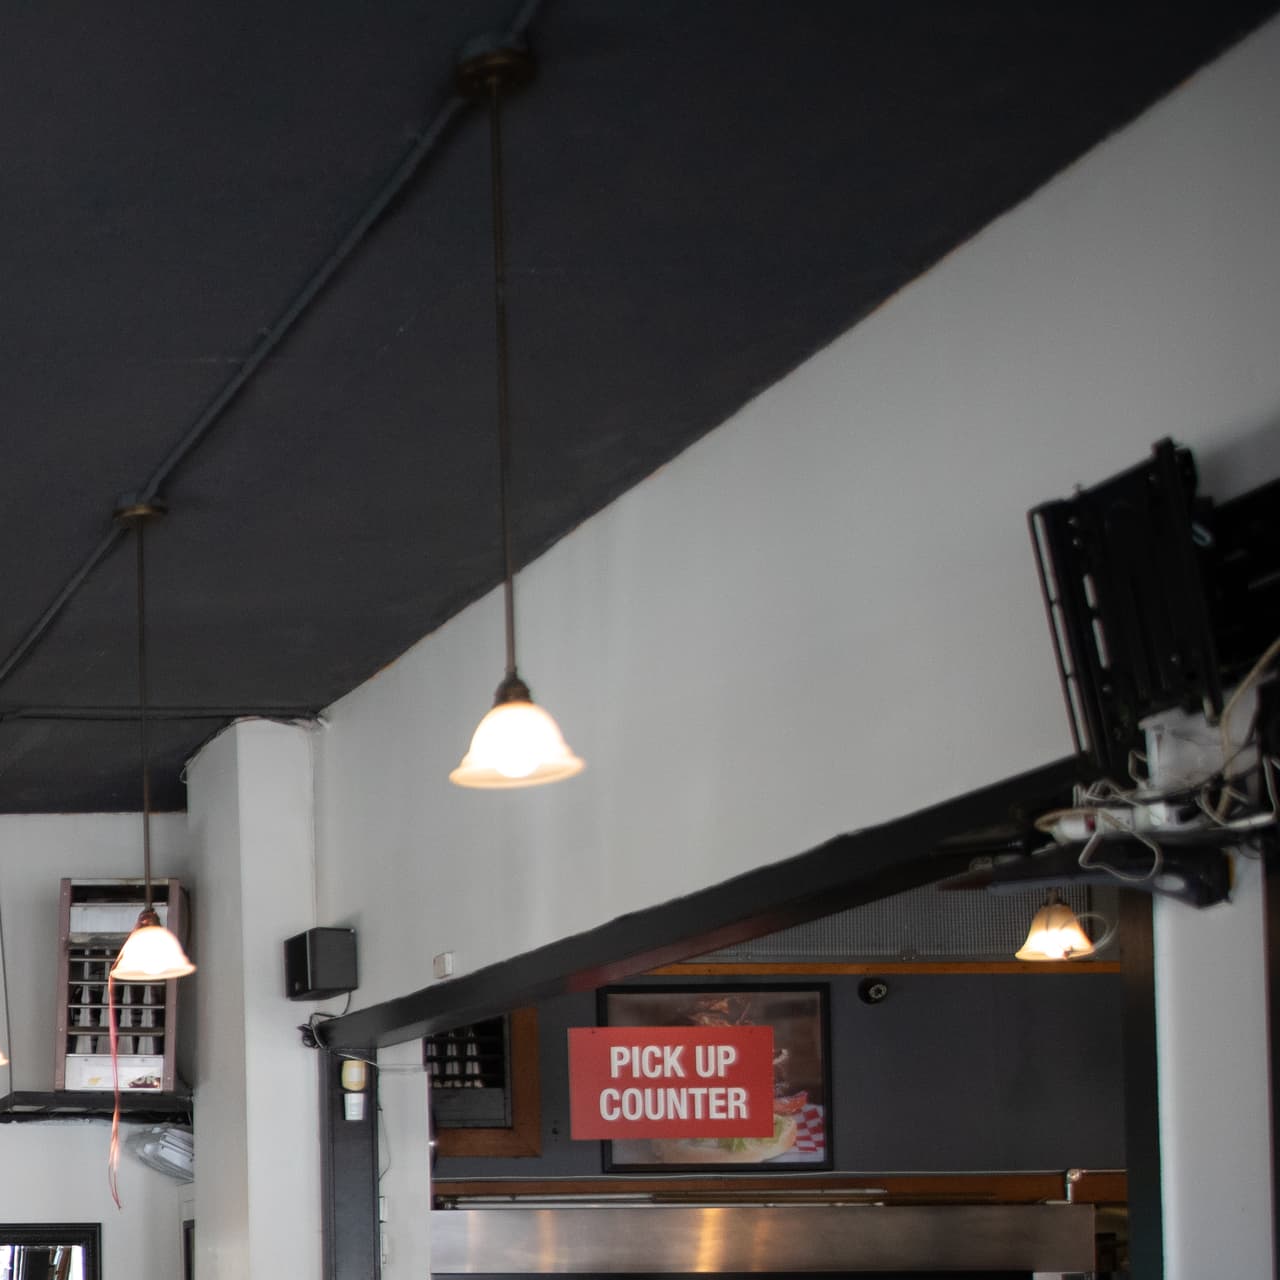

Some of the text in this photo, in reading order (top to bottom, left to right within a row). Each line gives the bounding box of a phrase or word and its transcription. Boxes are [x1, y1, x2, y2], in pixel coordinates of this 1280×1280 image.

[609, 1045, 737, 1078] PICK UP
[599, 1087, 748, 1121] COUNTER
